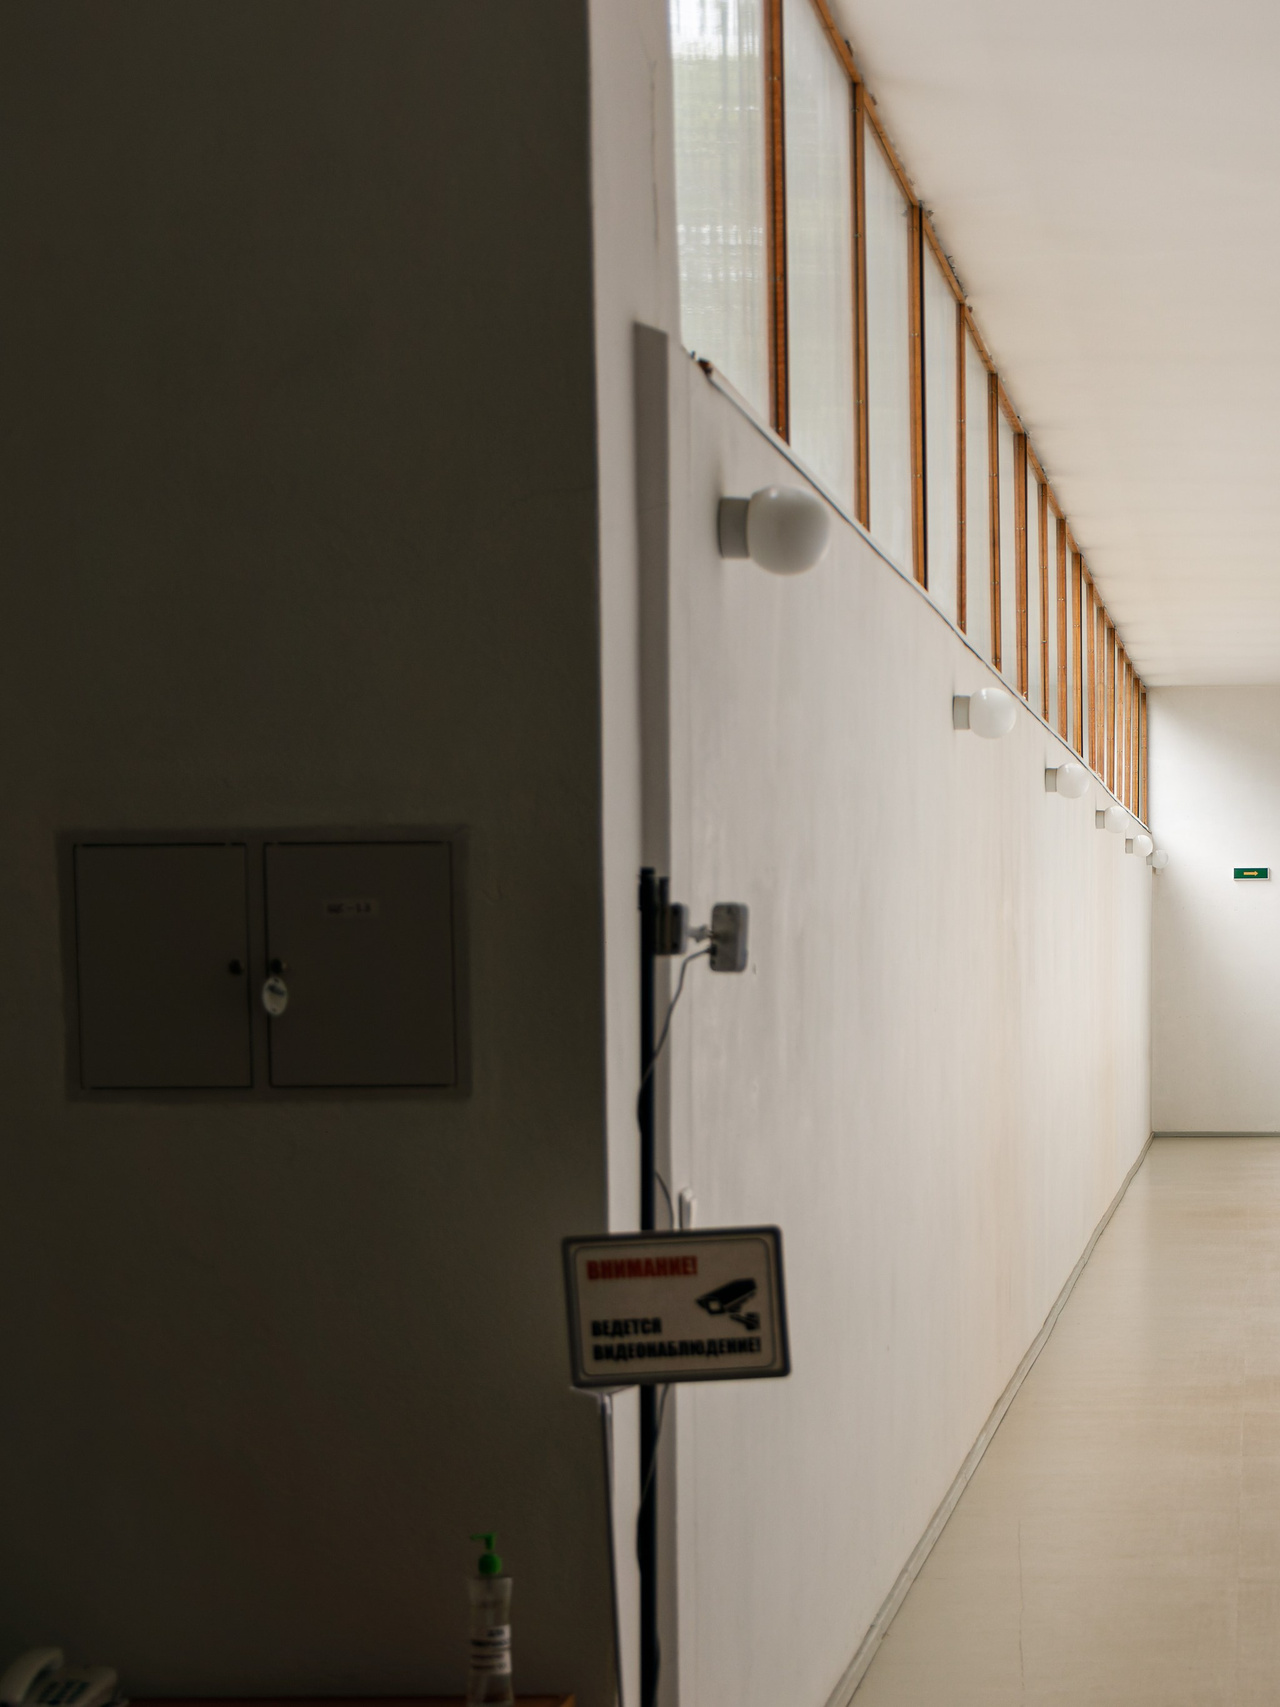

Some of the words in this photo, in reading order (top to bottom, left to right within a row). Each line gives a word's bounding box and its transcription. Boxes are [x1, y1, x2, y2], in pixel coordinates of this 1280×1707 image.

[587, 1255, 698, 1280] ВНИМАНИЕ!
[591, 1317, 662, 1337] ВЕДЕТСЯ
[593, 1337, 761, 1361] ВИДЕОНАБЛЮДЕНИЕ!
